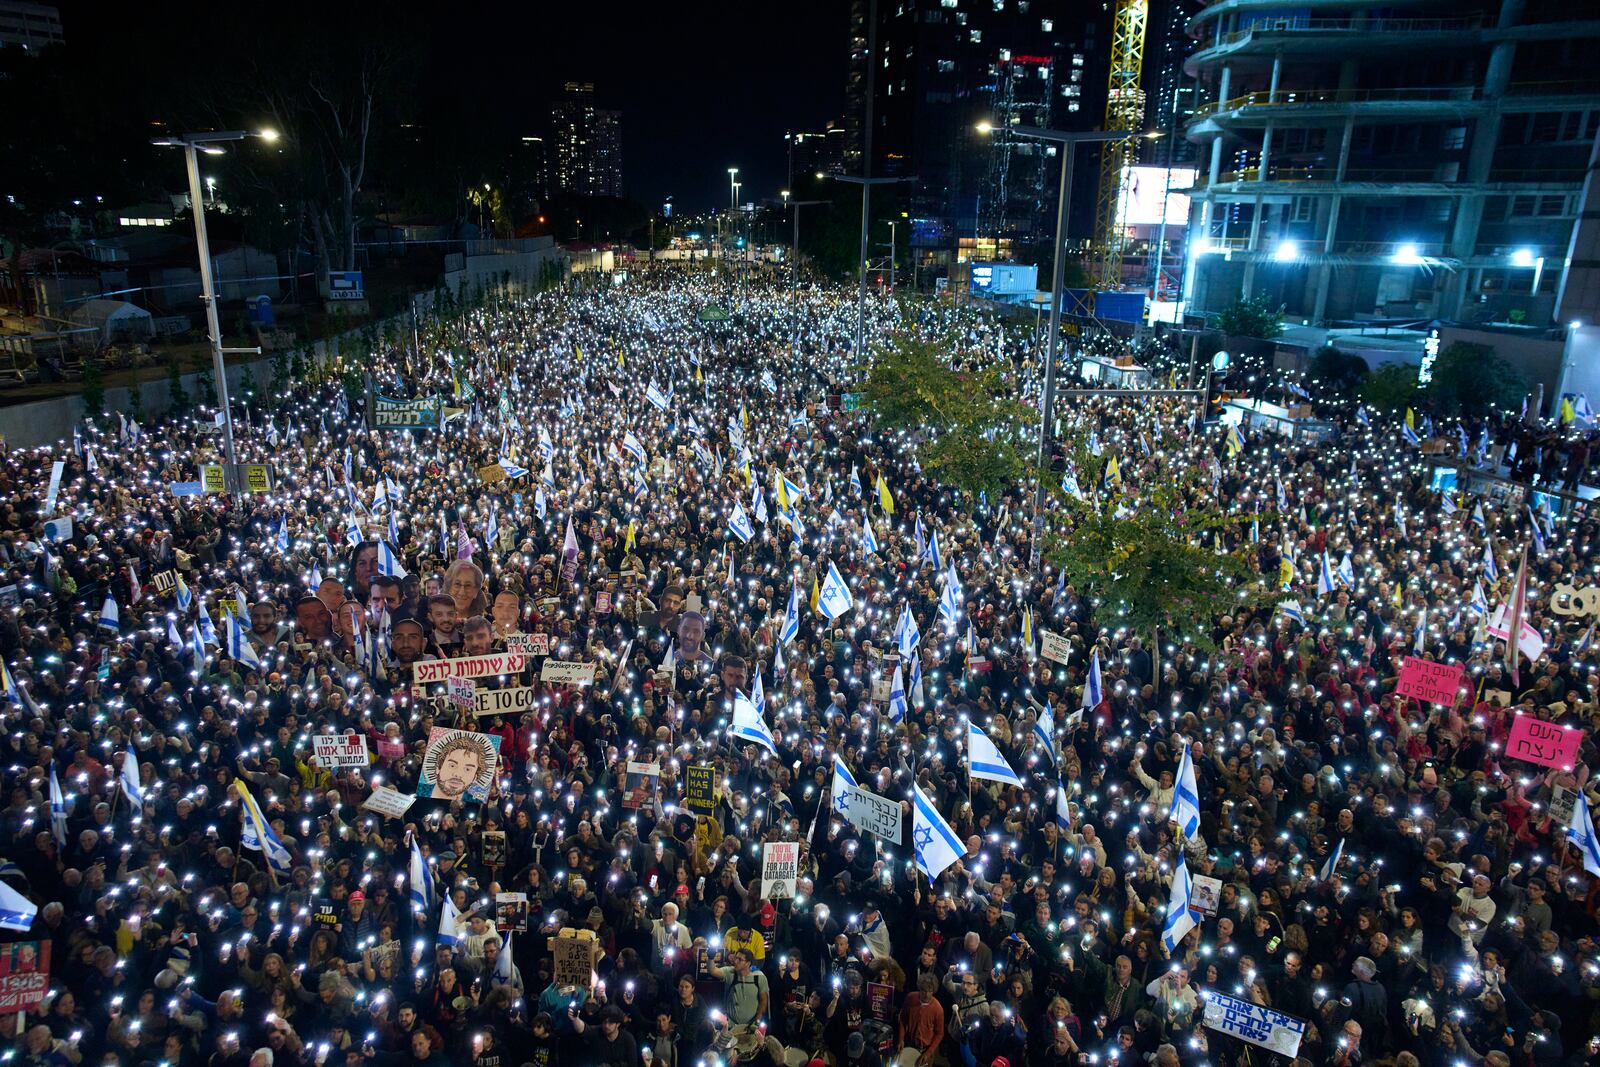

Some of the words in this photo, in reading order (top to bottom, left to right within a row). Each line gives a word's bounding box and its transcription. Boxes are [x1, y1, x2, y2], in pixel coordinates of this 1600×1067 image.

[375, 411, 421, 425] לנשק
[418, 661, 452, 680] לרגע
[455, 658, 503, 677] שוכחות
[1405, 659, 1429, 673] דורש
[1432, 667, 1456, 679] העם
[1418, 675, 1437, 687] את
[1402, 682, 1453, 702] החטופים
[492, 692, 511, 709] TO
[515, 690, 534, 707] GO
[1529, 723, 1563, 742] העם
[321, 736, 333, 744] לנו
[317, 745, 338, 757] אמון
[341, 745, 364, 756] חוסר
[1517, 739, 1563, 760] ינצח
[320, 756, 332, 766] בך
[334, 756, 364, 766] מתמשך
[690, 770, 709, 779] WAR
[690, 780, 708, 788] HAS
[690, 789, 702, 797] NO
[688, 799, 714, 808] WINNERS
[855, 792, 897, 818] נבצרות
[872, 810, 896, 827] לפני
[861, 817, 894, 838] שנמות
[772, 844, 792, 852] YOU'RE
[768, 853, 775, 861] TO
[776, 853, 794, 862] BLAME
[767, 862, 777, 870] FOR
[764, 870, 795, 880] QATARGATE
[320, 906, 333, 914] עד
[314, 912, 337, 923] מתי?
[1258, 1008, 1303, 1033] בארץ
[1222, 1019, 1268, 1042] לאורח
